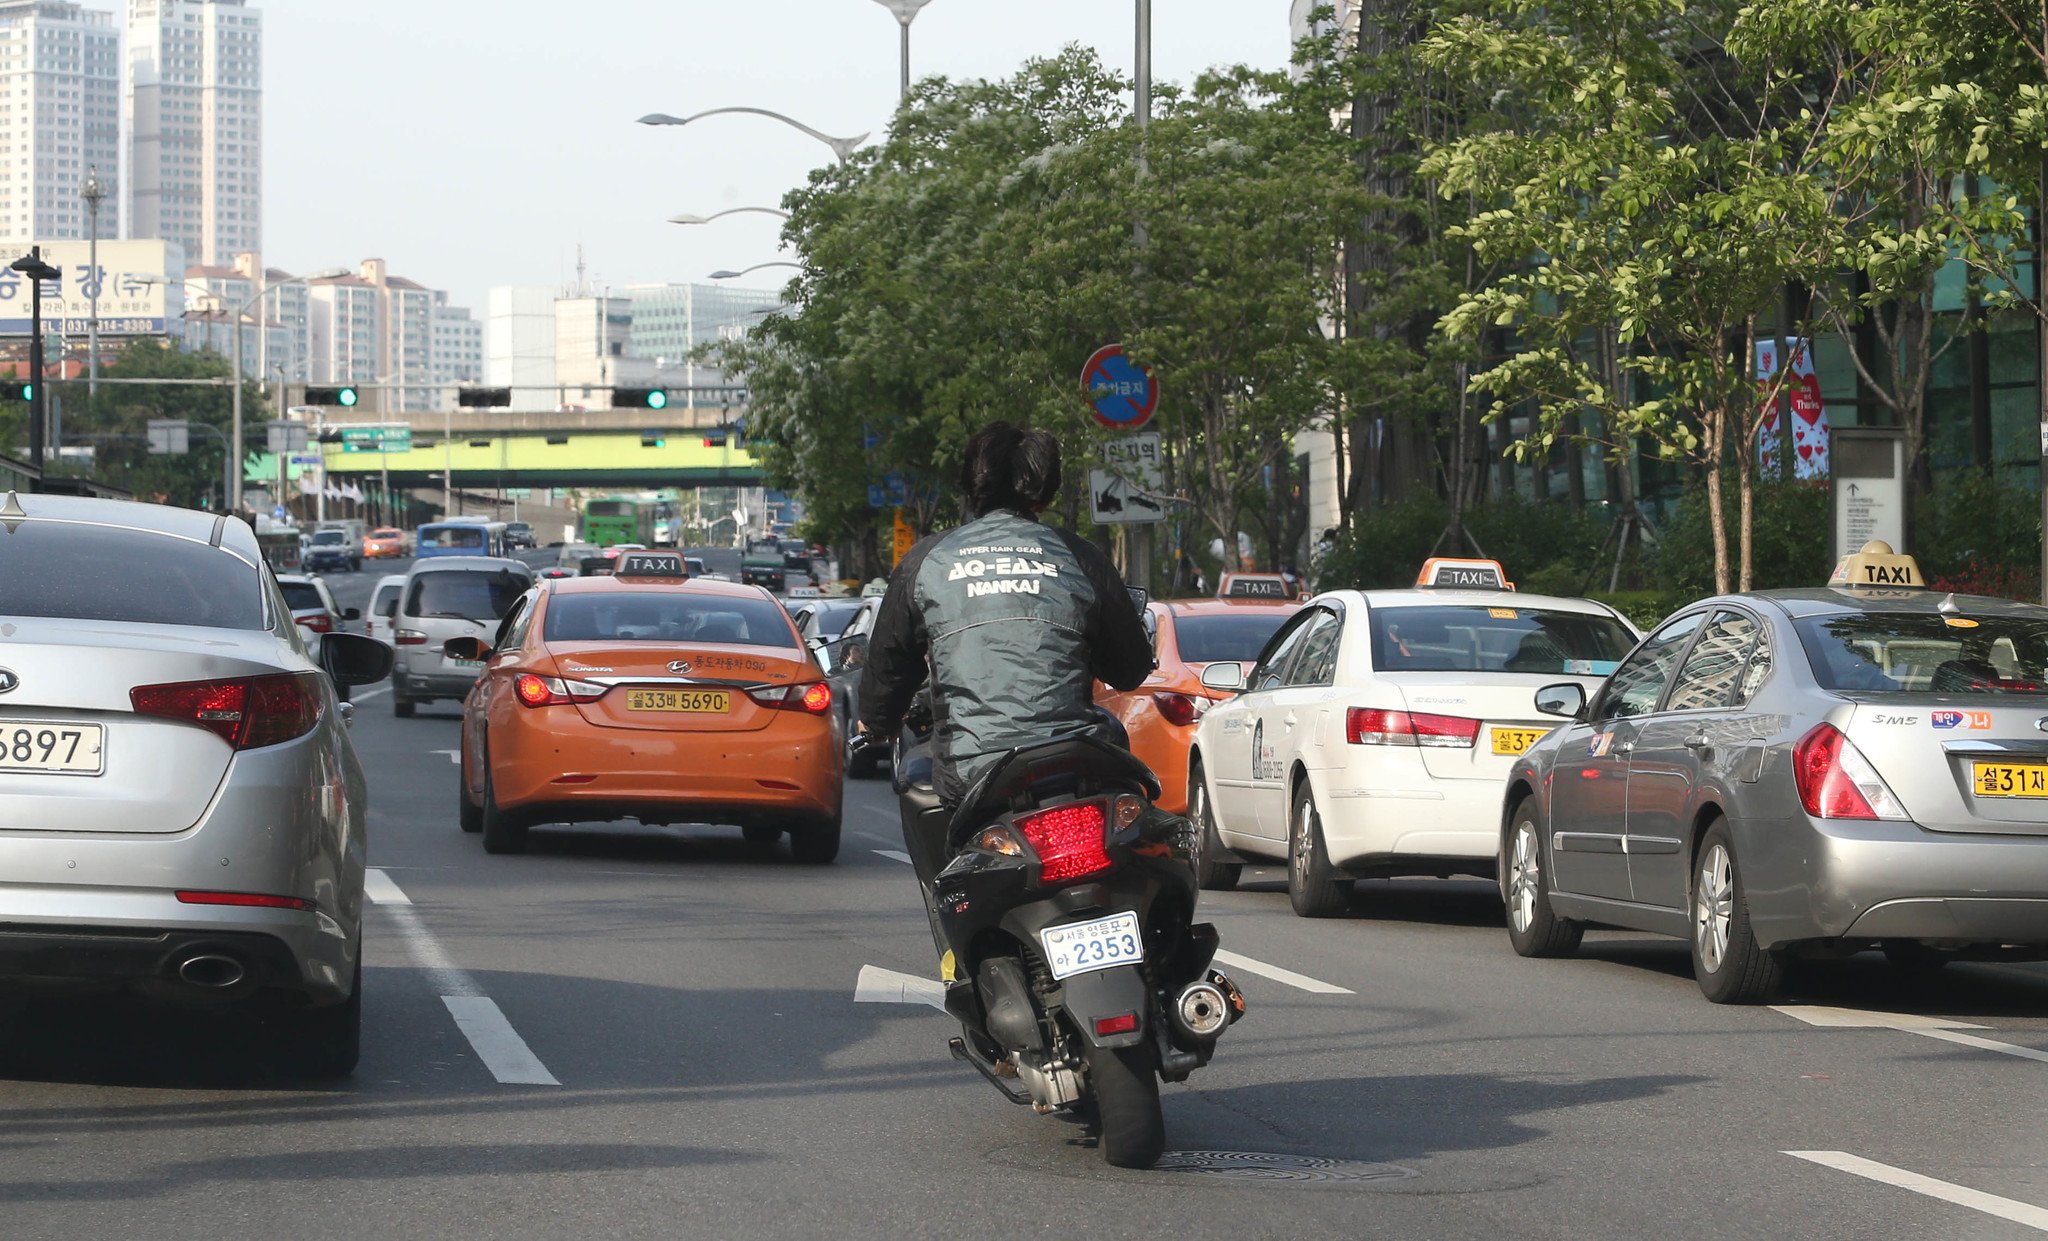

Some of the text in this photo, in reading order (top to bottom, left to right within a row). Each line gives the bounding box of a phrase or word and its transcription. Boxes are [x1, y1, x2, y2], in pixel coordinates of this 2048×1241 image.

[959, 546, 990, 556] HYPER
[1015, 547, 1043, 555] GEAR
[630, 558, 675, 570] TAXI
[1452, 571, 1482, 585] TAXI
[1865, 565, 1912, 584] TAXI
[1244, 582, 1271, 594] TAXI
[695, 655, 766, 672] 동도자동차 090
[681, 694, 723, 710] 5690
[1872, 715, 1919, 725] SM5
[1933, 712, 1954, 725] 개인
[1073, 934, 1136, 965] 2353
